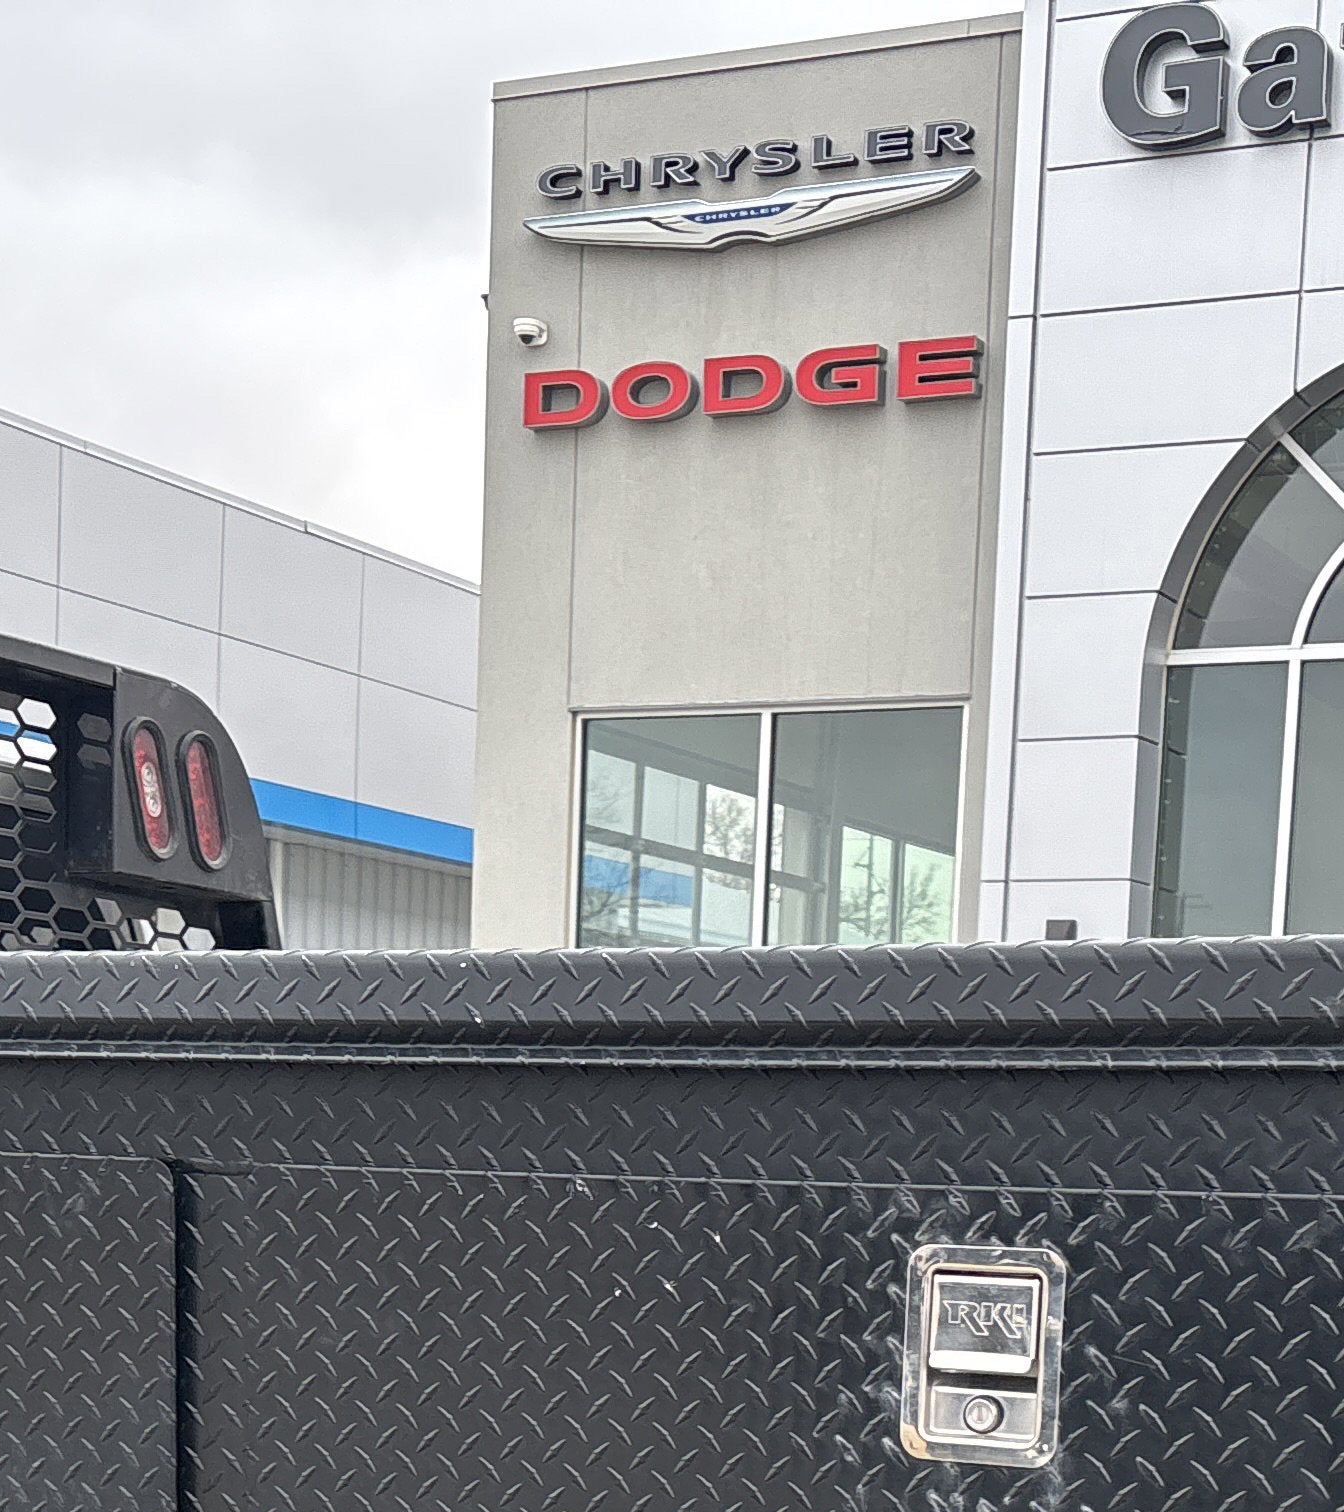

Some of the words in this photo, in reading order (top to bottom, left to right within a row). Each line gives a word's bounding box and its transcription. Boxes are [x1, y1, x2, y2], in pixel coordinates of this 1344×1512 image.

[536, 119, 976, 199] CHRYSLER
[694, 206, 781, 222] CHRYSLER
[523, 335, 984, 432] DODGE
